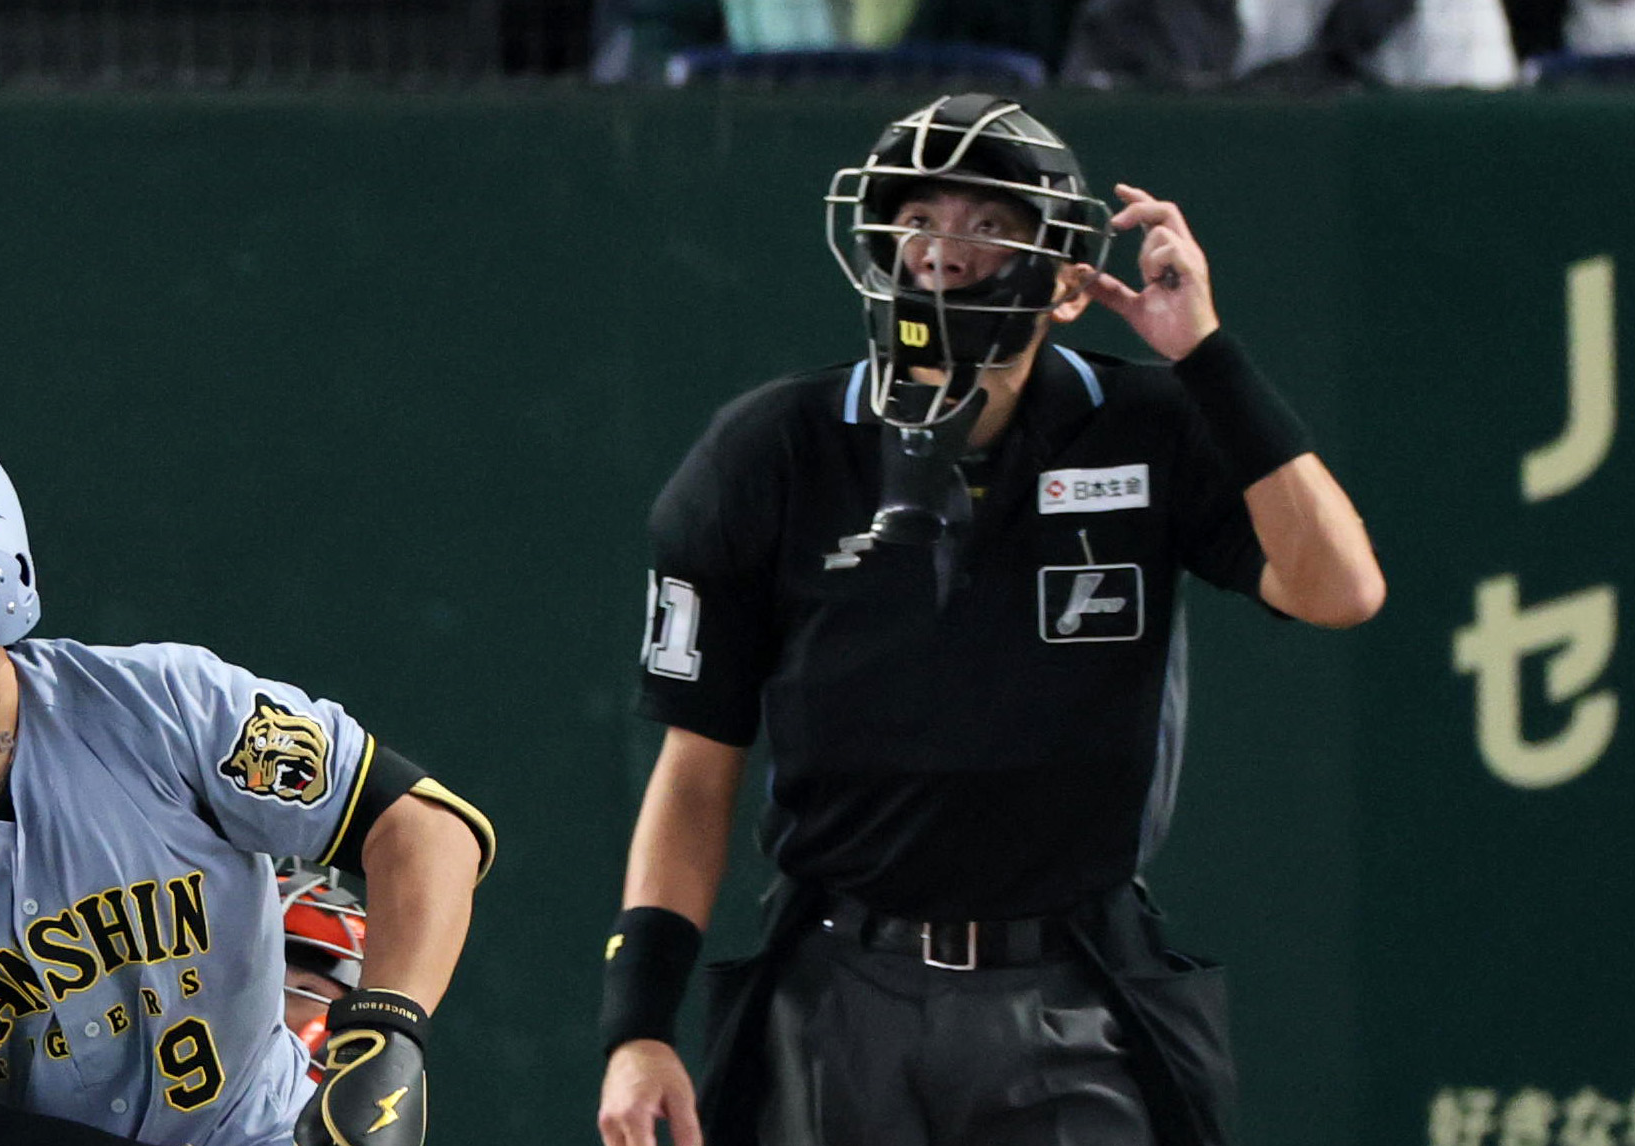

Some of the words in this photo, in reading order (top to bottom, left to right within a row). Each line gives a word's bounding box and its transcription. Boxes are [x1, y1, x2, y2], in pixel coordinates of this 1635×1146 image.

[1520, 255, 1617, 502] J
[640, 568, 702, 682] 1
[1451, 572, 1618, 788] セ
[155, 1015, 226, 1112] 9
